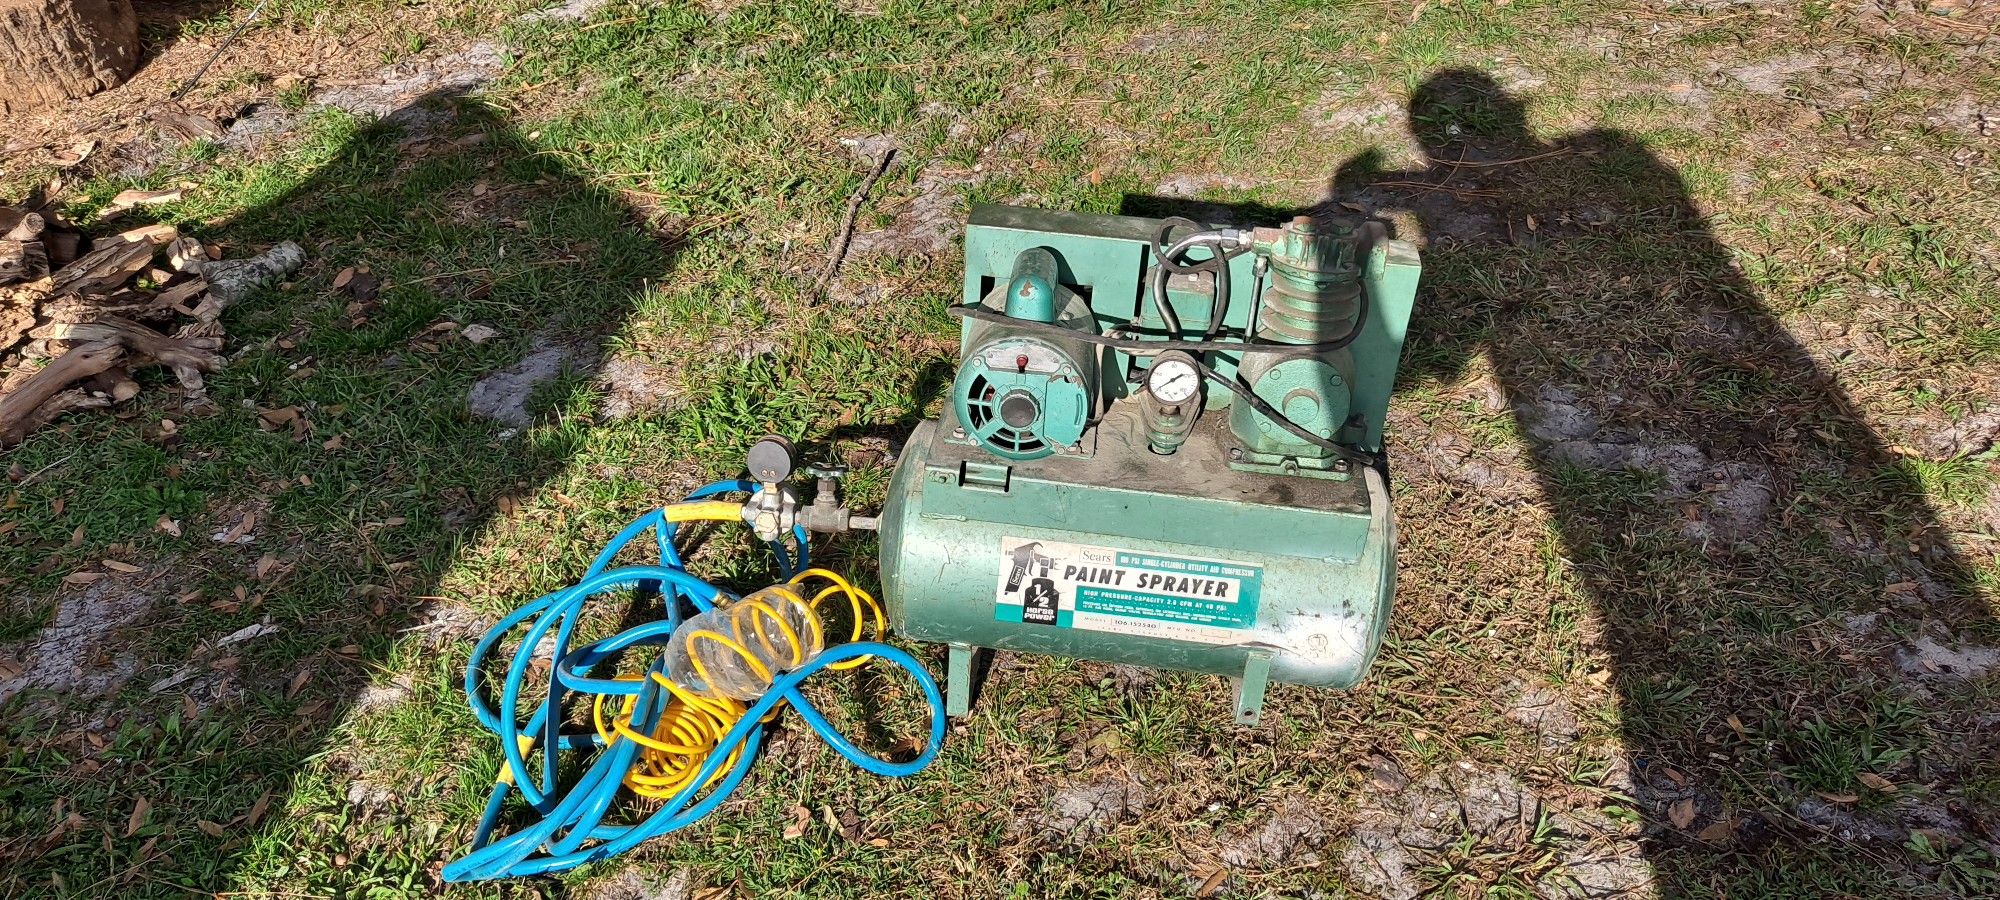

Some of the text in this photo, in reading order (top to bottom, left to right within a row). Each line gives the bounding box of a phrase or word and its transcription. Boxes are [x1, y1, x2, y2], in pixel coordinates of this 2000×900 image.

[1083, 550, 1111, 562] Sears
[1063, 564, 1229, 597] PAINT SPRAYER
[1026, 607, 1054, 615] Horse
[1024, 612, 1055, 621] Power
